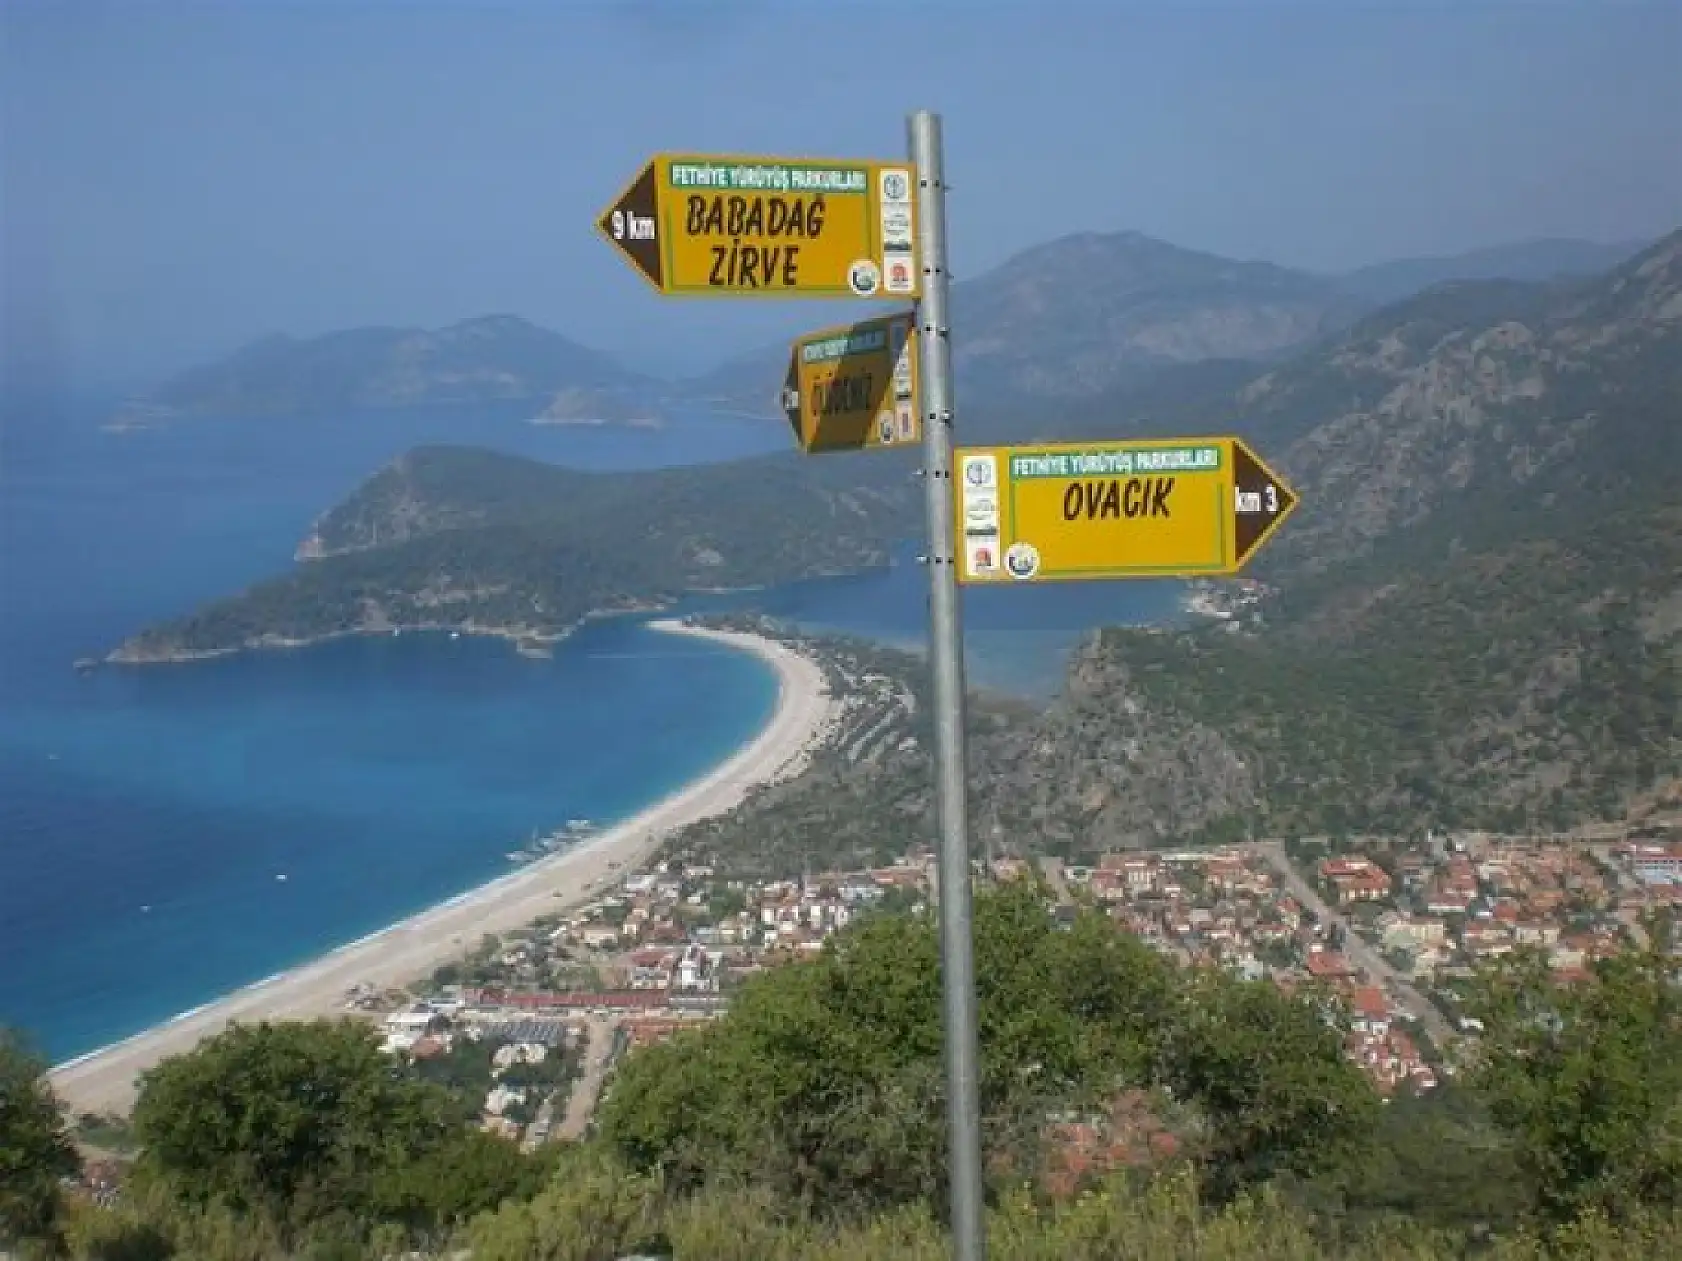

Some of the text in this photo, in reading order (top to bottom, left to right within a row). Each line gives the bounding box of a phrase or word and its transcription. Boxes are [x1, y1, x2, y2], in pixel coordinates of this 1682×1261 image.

[611, 210, 656, 240] 9 km
[687, 193, 826, 239] BABADAĞ
[708, 238, 801, 288] ZİRVE
[1062, 477, 1176, 521] OVACIK
[1234, 483, 1278, 512] km 3
